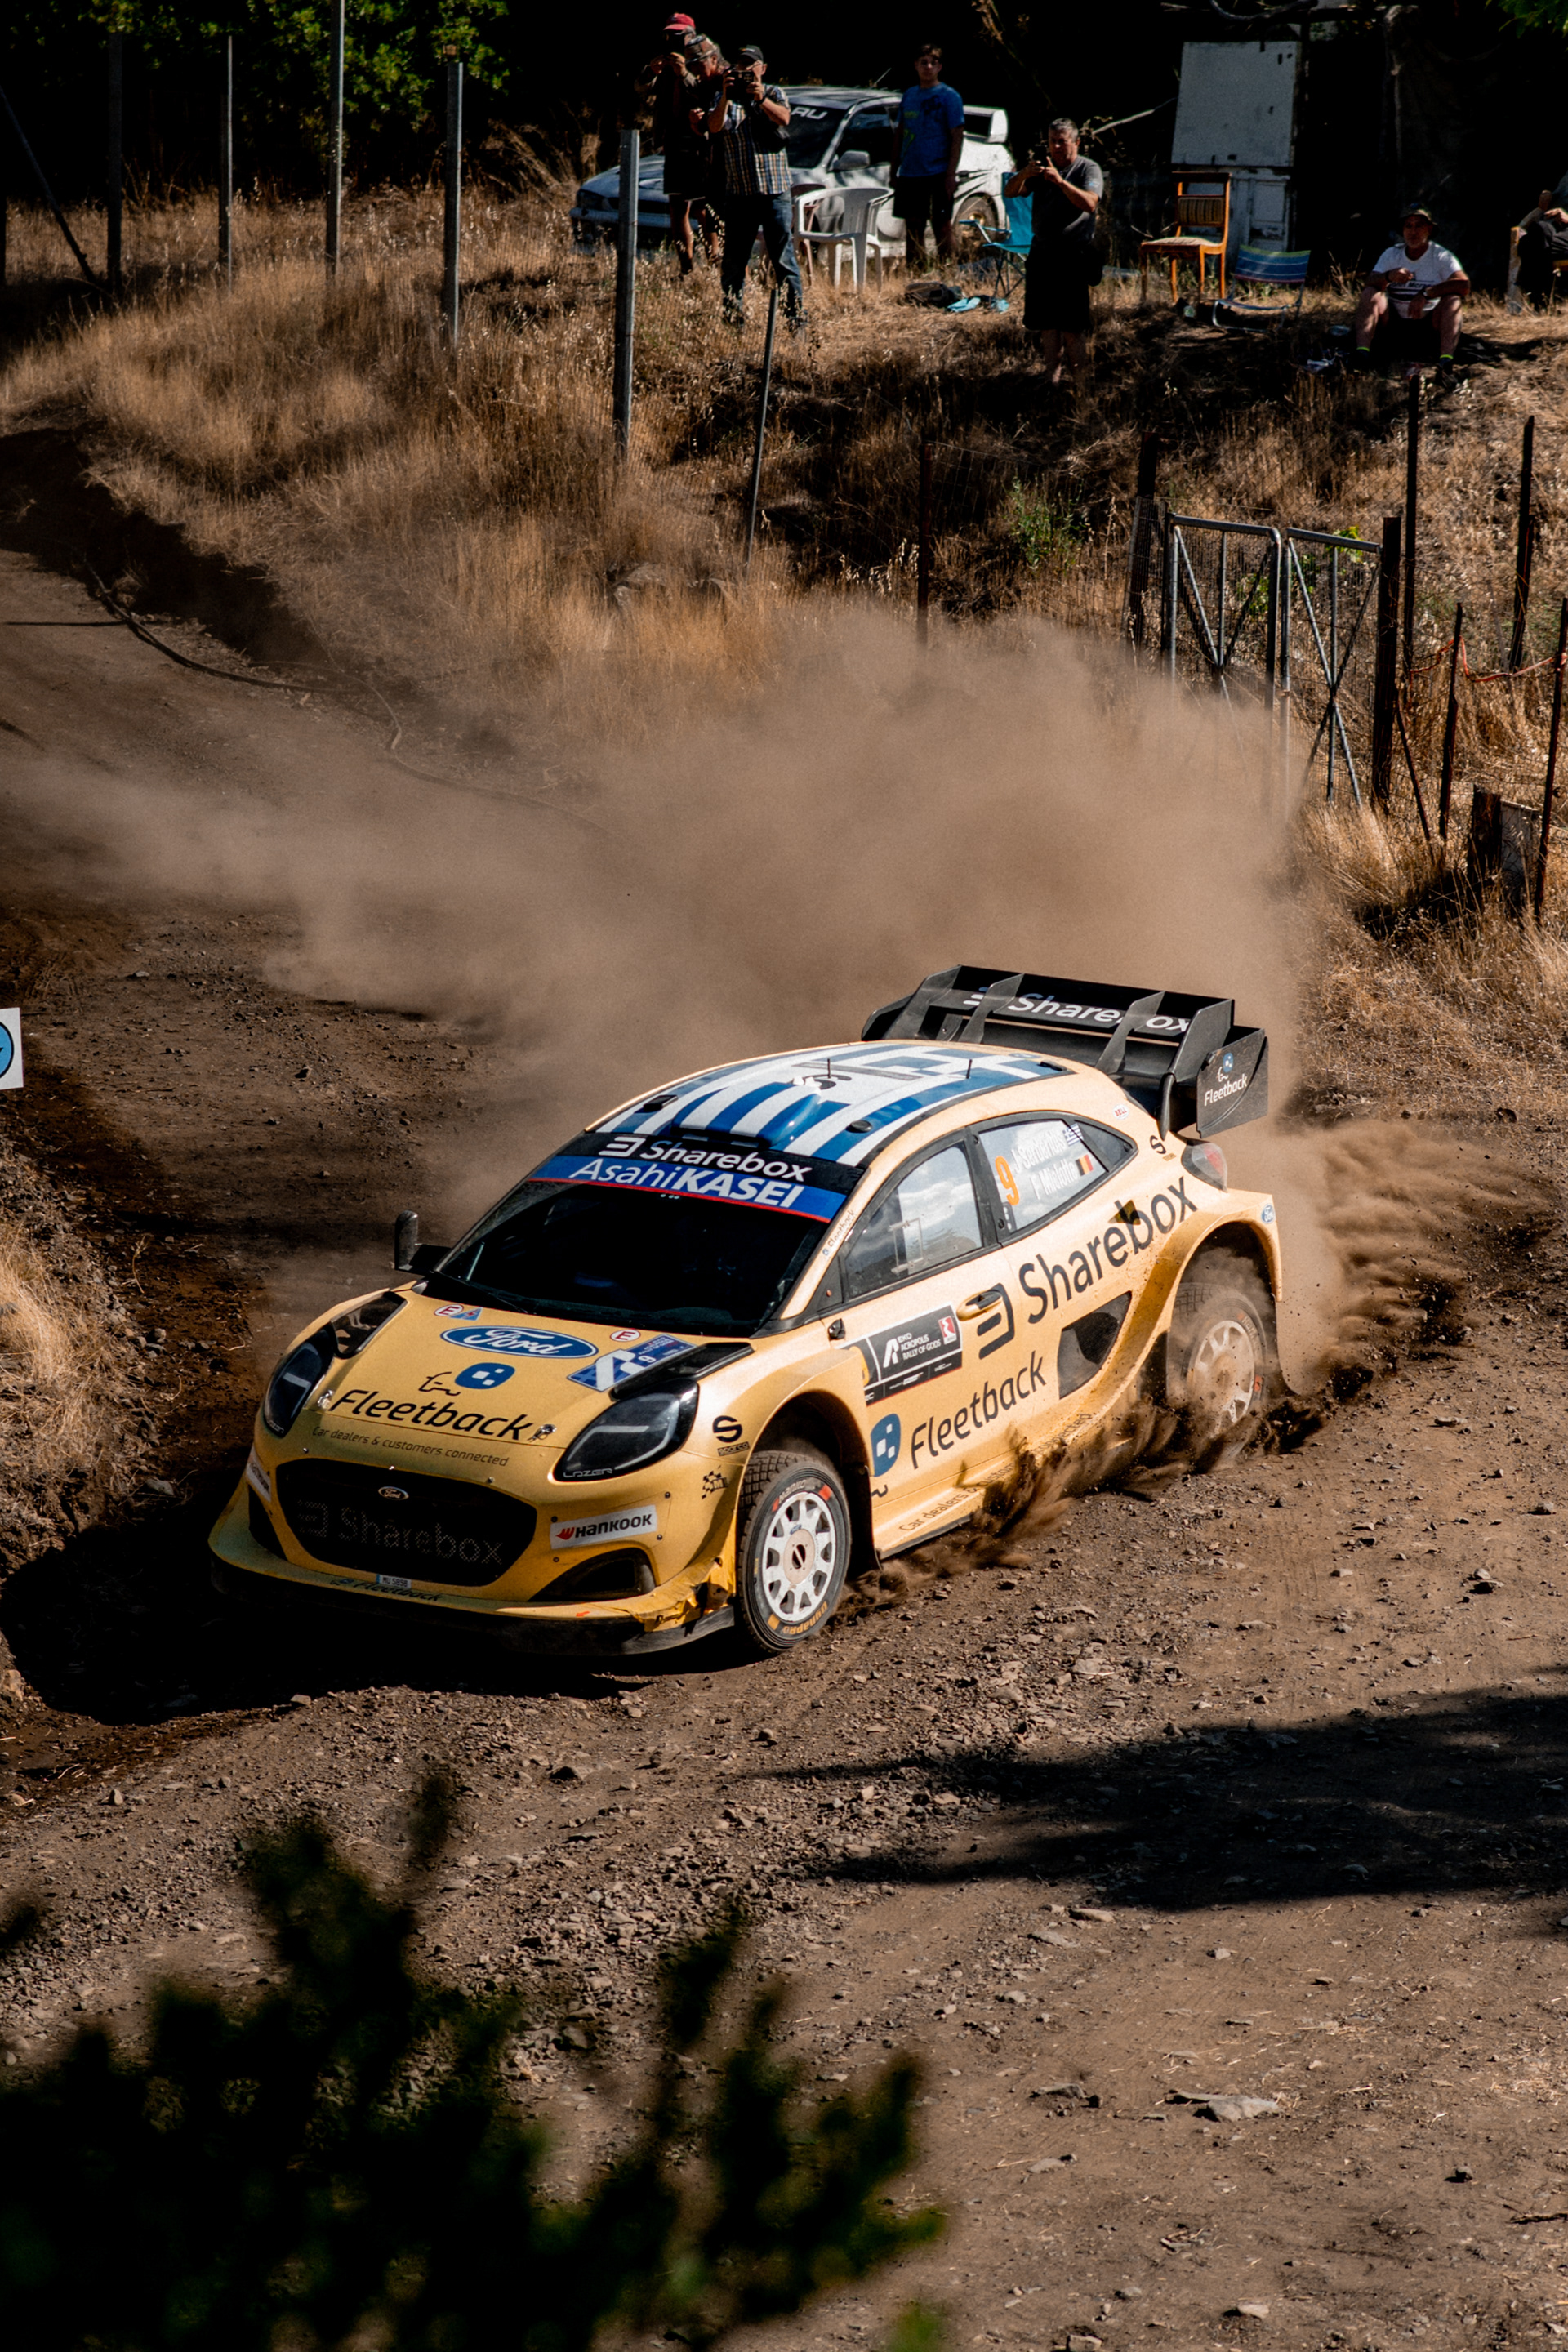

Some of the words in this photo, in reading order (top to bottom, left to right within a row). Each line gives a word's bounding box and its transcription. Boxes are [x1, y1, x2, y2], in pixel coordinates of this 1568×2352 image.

[1007, 993, 1189, 1032] Shareox
[1204, 1074, 1248, 1107] Fleetback
[1114, 1107, 1128, 1117] BELL
[639, 1139, 813, 1182] Sharebox
[568, 1158, 805, 1209] AsahiKASEI
[995, 1156, 1020, 1205] 9
[1018, 1176, 1199, 1324] Sharebox
[438, 1307, 459, 1316] E
[463, 1328, 573, 1355] Ford
[615, 1331, 636, 1340] E
[897, 1332, 912, 1343] EKO
[900, 1334, 930, 1352] ACROPOLIS
[902, 1348, 919, 1361] RALLY
[918, 1346, 926, 1354] OF
[926, 1339, 942, 1351] GODS
[638, 1355, 657, 1364] 9
[327, 1389, 533, 1441] Fleetback
[910, 1350, 1046, 1470] Fleetback
[312, 1426, 329, 1437] Car
[330, 1428, 369, 1445] dealers
[371, 1436, 381, 1446] &
[382, 1437, 443, 1455] customers
[445, 1448, 510, 1467] connected
[898, 1518, 925, 1531] Car
[921, 1493, 969, 1519] dealers
[338, 1507, 503, 1566] Sharebox
[353, 1581, 443, 1601] Fleetback
